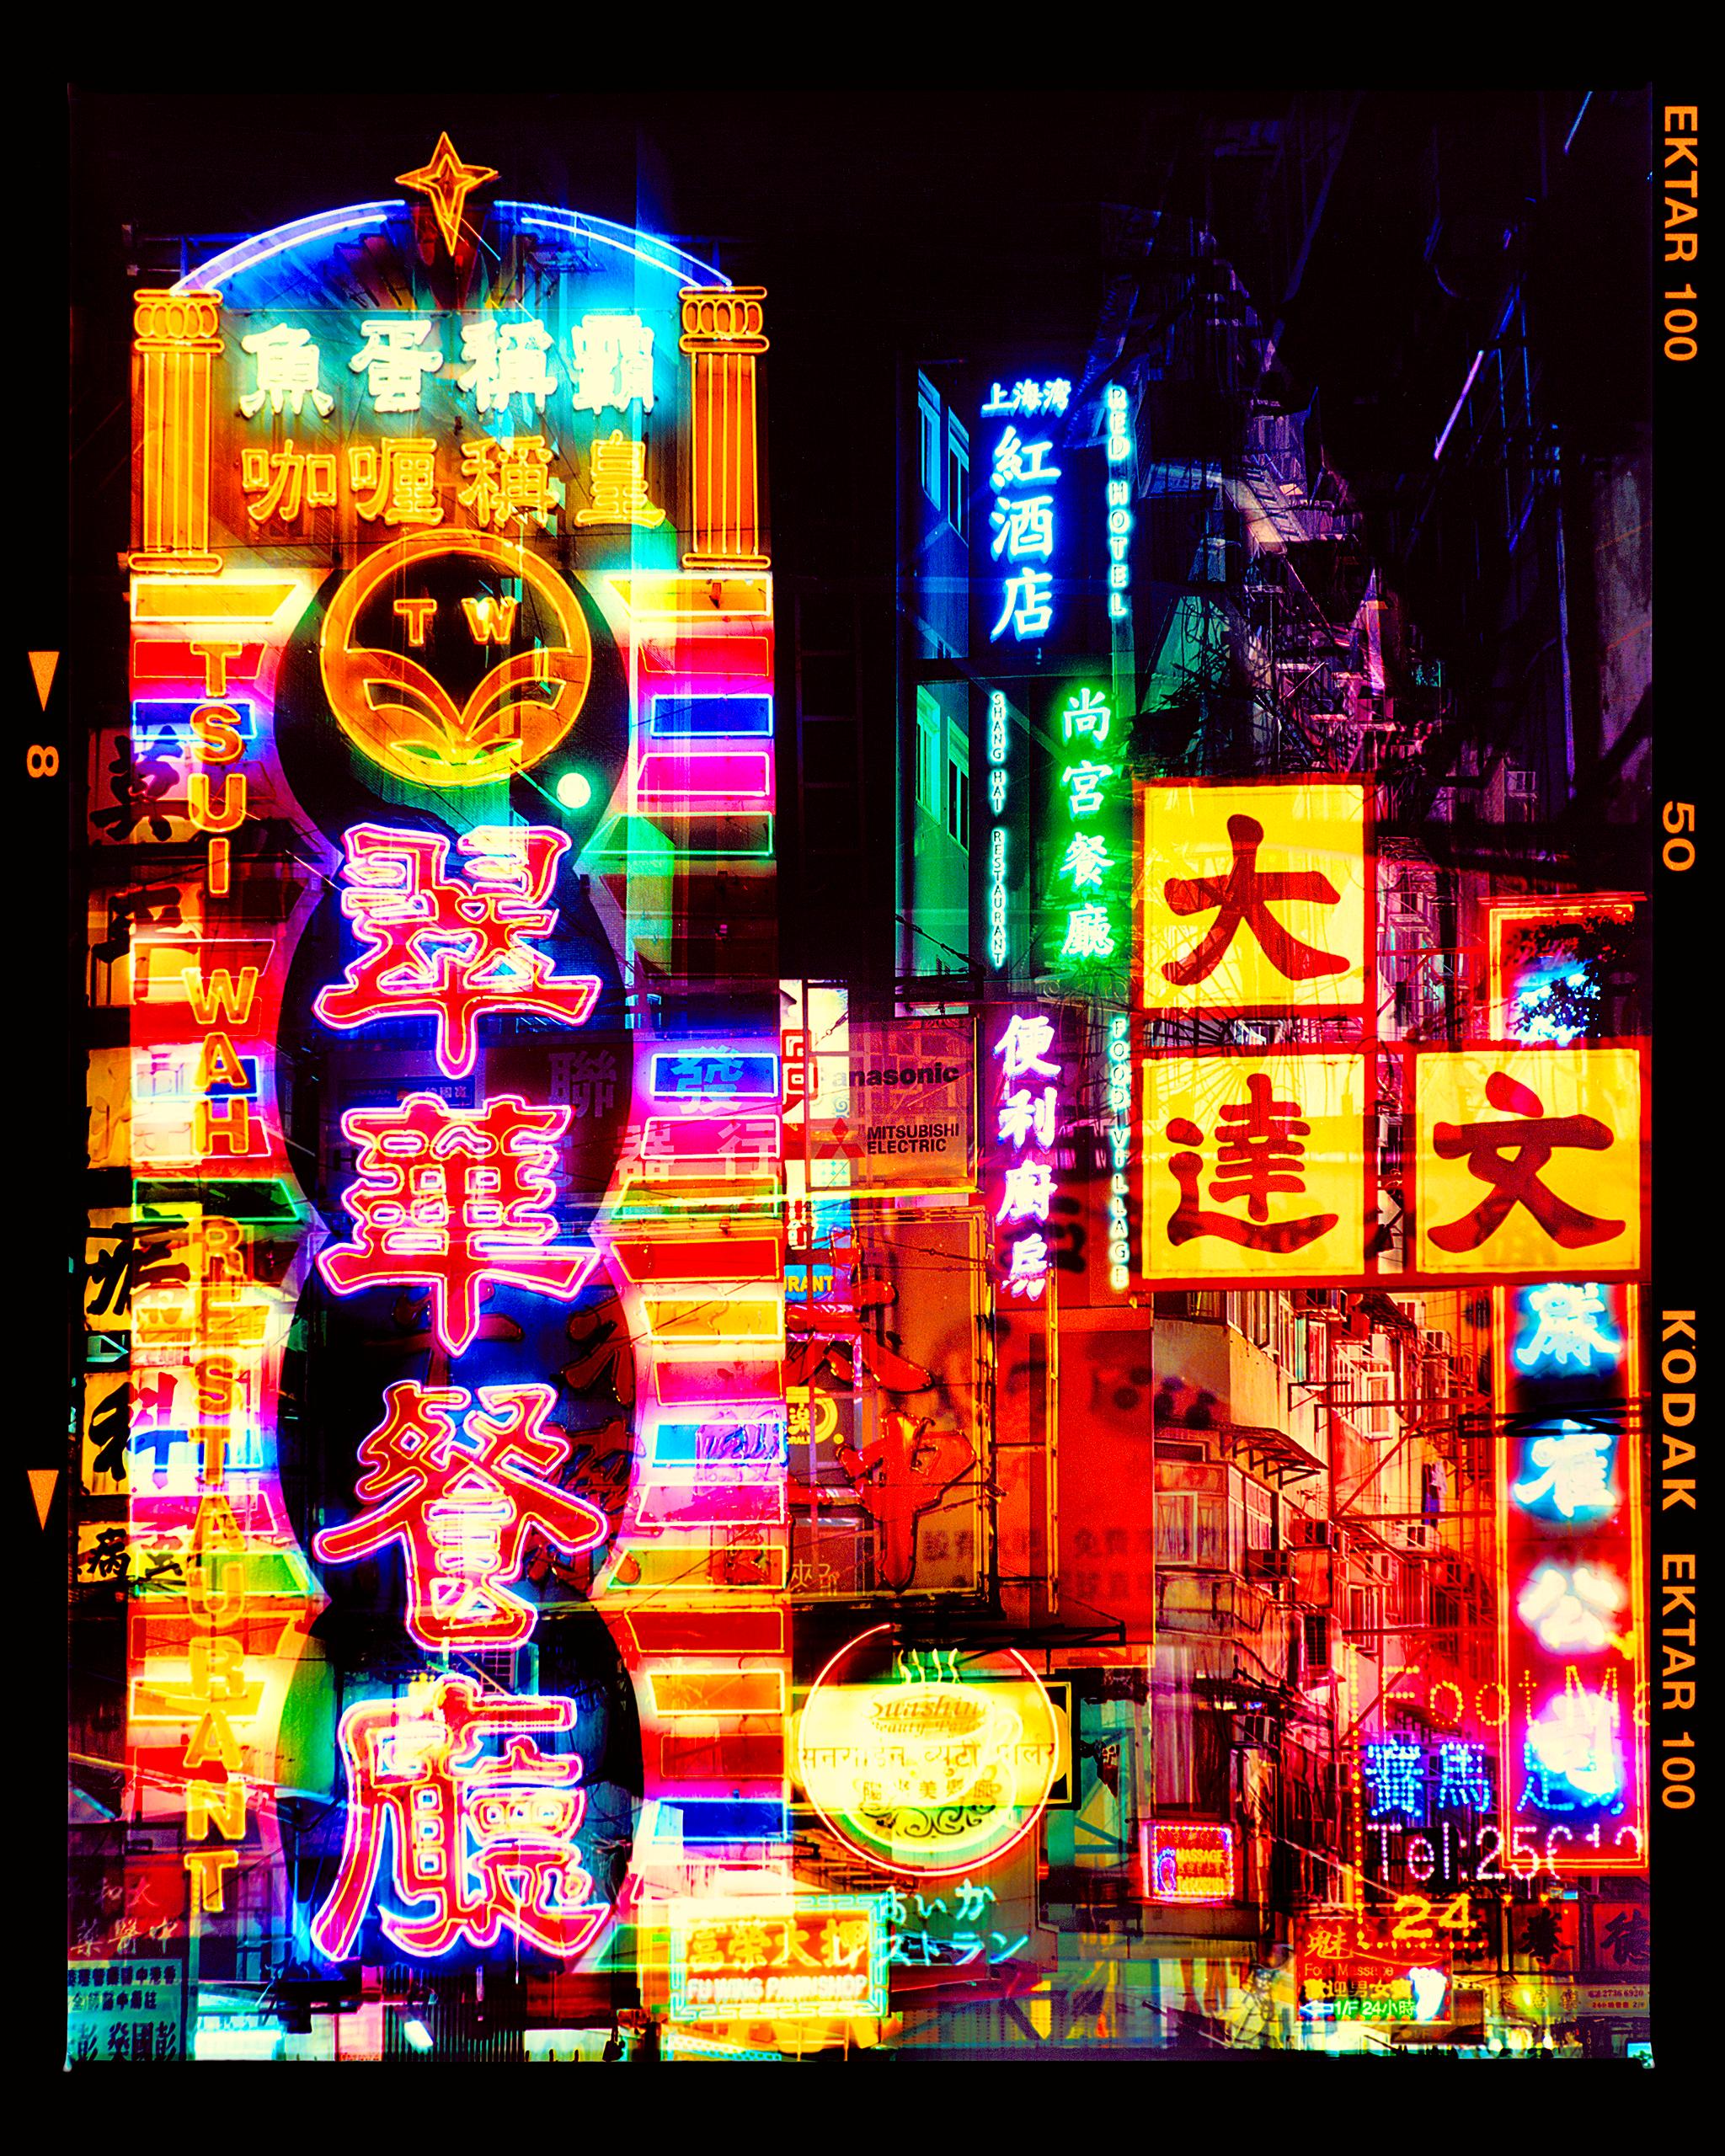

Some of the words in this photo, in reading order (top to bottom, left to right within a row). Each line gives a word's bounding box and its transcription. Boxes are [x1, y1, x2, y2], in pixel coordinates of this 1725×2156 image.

[1108, 386, 1130, 460] RED
[990, 424, 1062, 644] 紅酒店
[1108, 481, 1130, 616] HOTEL
[186, 642, 249, 895] TSUI
[991, 693, 1005, 760] SHANG
[991, 771, 1005, 812] HAI
[1060, 687, 1116, 958] 尚宮餐廳
[991, 830, 1005, 967] RESTAURANT
[180, 967, 259, 1157] WAH
[1111, 1019, 1130, 1108] FOOD
[867, 1123, 960, 1140] MITSUBISHI
[867, 1138, 948, 1155] ELECTRIC
[1111, 1129, 1130, 1287] VILLAGE
[312, 822, 610, 1962] 翠華餐廳
[185, 1214, 247, 1913] RESTAURANT
[1381, 1665, 1537, 1726] Foot
[1304, 1963, 1333, 1977] Foo
